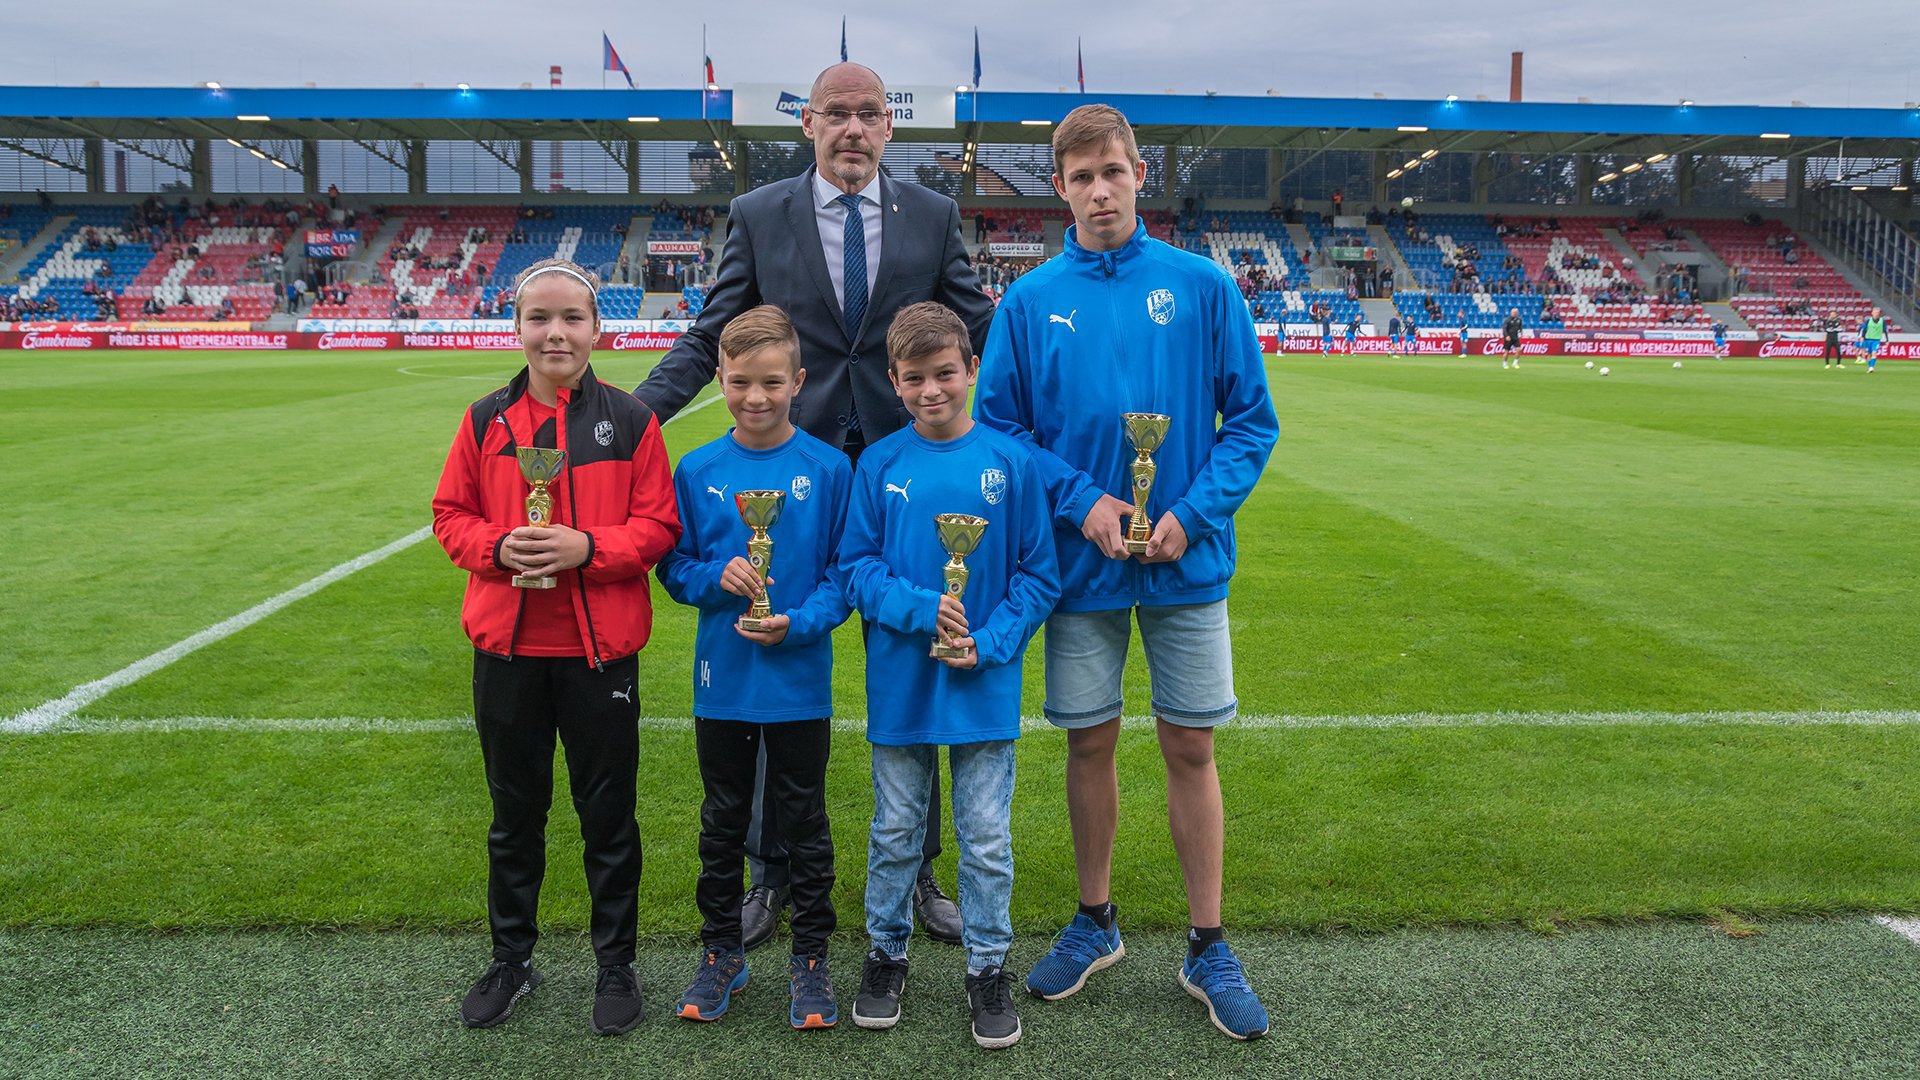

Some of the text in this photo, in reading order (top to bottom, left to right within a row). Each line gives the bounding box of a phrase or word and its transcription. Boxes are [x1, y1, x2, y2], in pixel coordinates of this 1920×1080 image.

[886, 92, 913, 103] san
[450, 320, 515, 332] fontan
[1267, 328, 1311, 336] POLAHY
[22, 332, 92, 349] Gambrinus
[109, 332, 287, 346] PŘIDEJ SE NA KOPEMEZAFOTBAL.CZ
[318, 332, 387, 349] Gambrinus
[404, 332, 523, 346] PŘIDEJ SE NA KOPEMEZ
[612, 333, 675, 349] Gambrinu
[1283, 337, 1318, 350] PŘIDEJ
[1482, 338, 1549, 355] Garinus
[1564, 339, 1730, 354] PŘIDEJ SE NA KOPEMEZAFOTBALZ
[1759, 340, 1824, 357] Gambrinus
[1890, 345, 1906, 356] NA
[701, 660, 710, 688] 14
